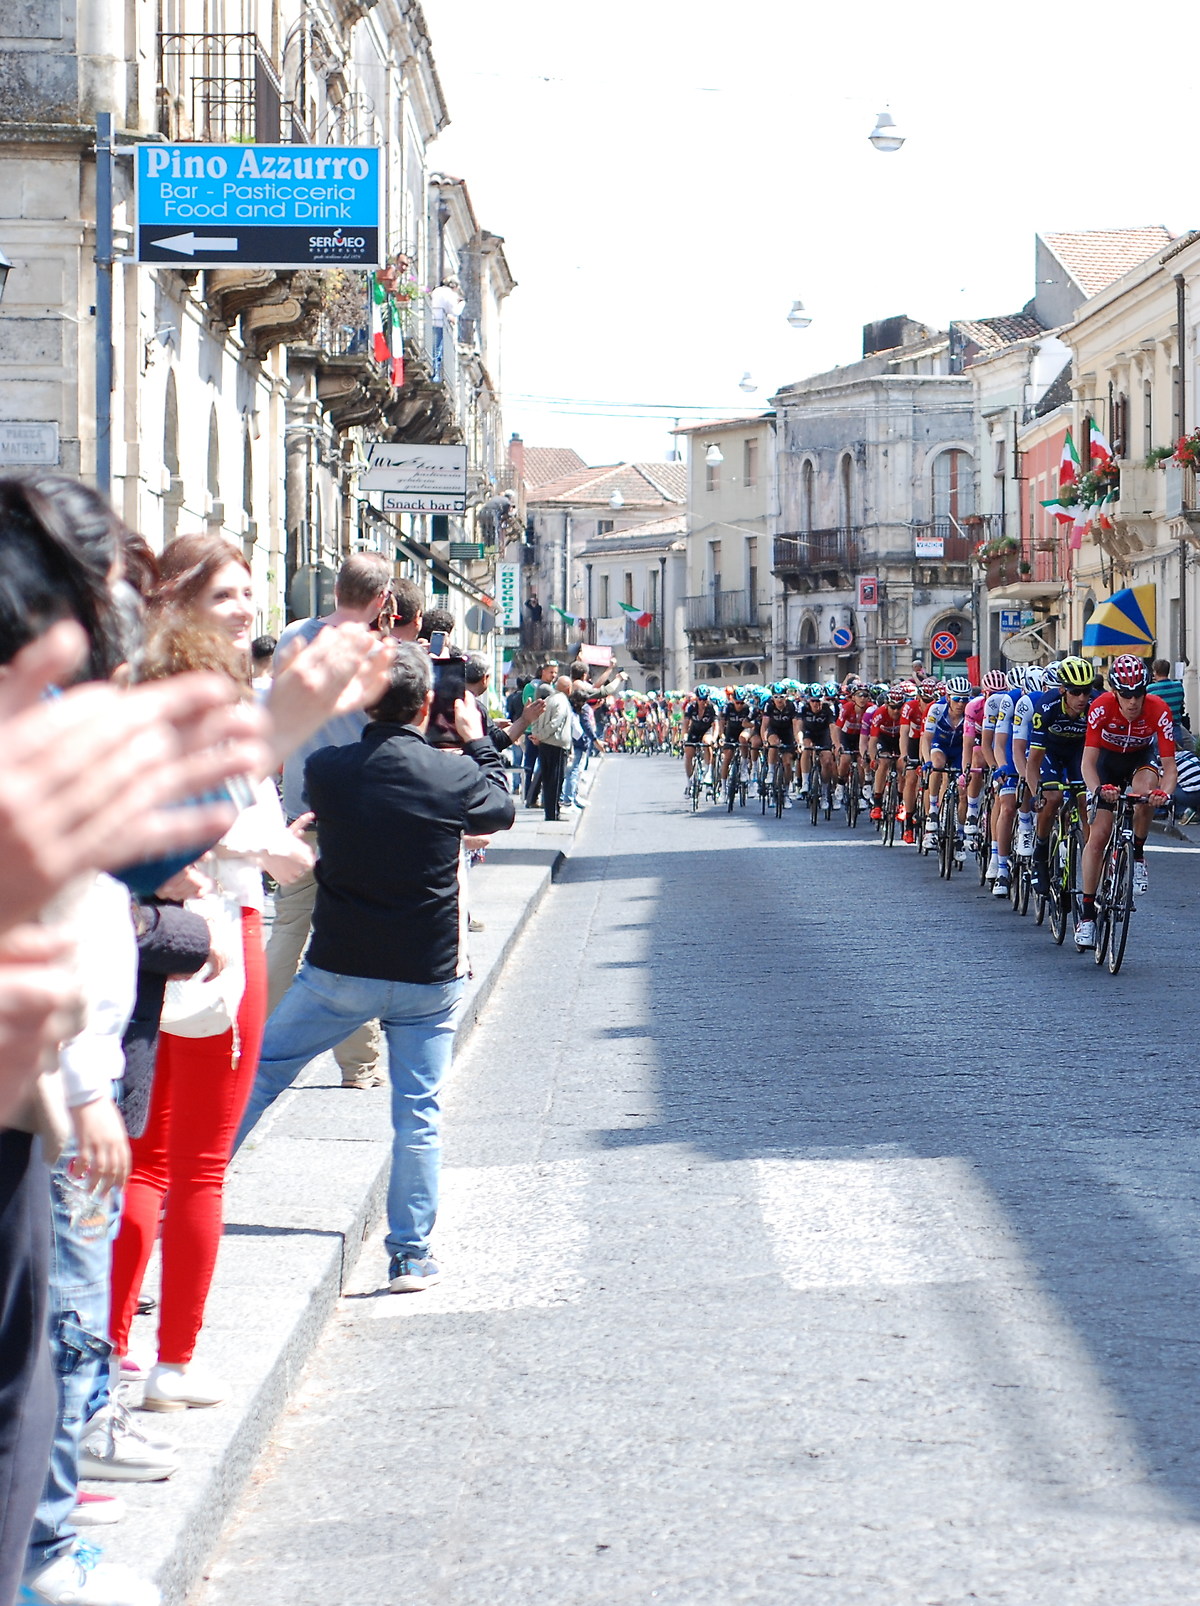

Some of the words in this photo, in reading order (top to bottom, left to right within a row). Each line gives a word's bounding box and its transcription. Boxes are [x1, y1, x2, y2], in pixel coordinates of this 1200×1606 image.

[146, 148, 228, 179] Pino
[236, 149, 369, 180] Azzurro
[160, 182, 198, 199] Bar
[223, 183, 355, 200] Pasticceria
[165, 201, 227, 217] Food
[236, 201, 286, 218] and
[295, 201, 352, 219] Drink
[309, 236, 365, 248] SERMEO
[386, 498, 425, 510] Snack
[430, 499, 452, 511] bar
[1087, 705, 1106, 725] CAPS
[1063, 725, 1087, 733] ORIC
